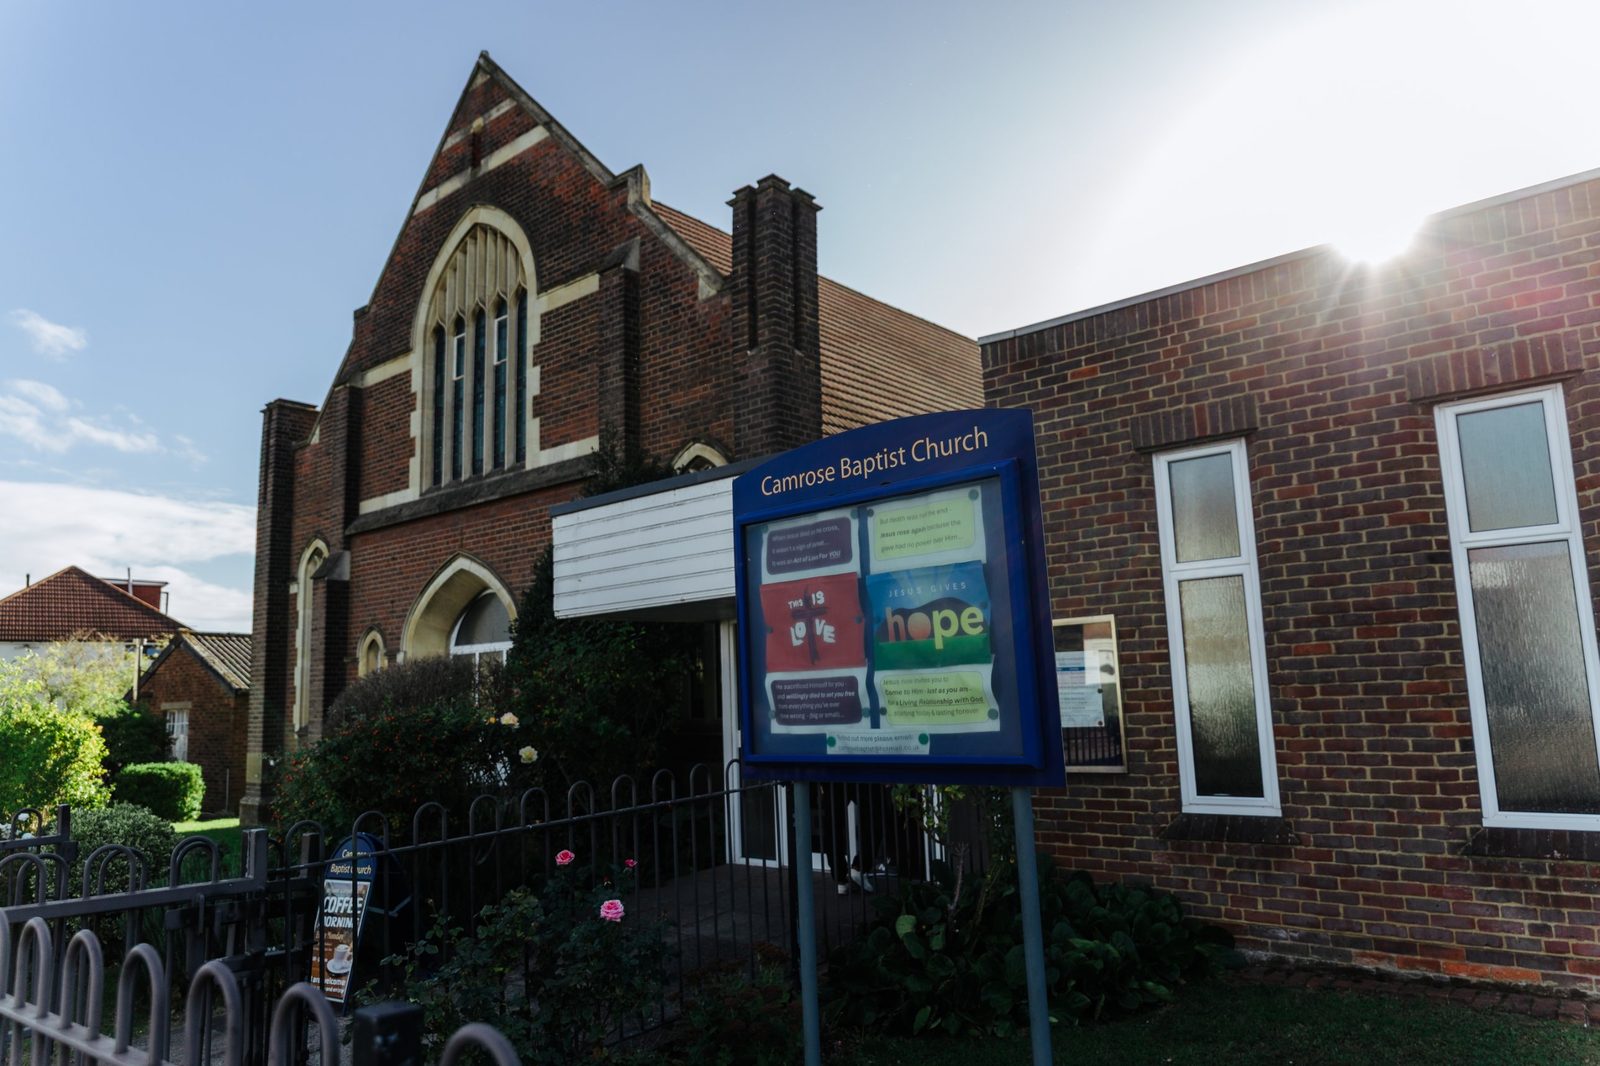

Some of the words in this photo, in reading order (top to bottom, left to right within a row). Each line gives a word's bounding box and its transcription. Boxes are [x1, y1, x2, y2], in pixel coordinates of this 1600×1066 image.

[760, 464, 835, 496] Camrose
[840, 446, 906, 480] Baptist
[911, 426, 988, 462] Church
[888, 586, 922, 598] JESUS
[930, 581, 967, 592] GIVES
[788, 598, 804, 609] THIS
[811, 591, 825, 605] IS
[790, 618, 836, 646] LOVE
[885, 606, 984, 650] hope
[330, 864, 350, 874] Baptist
[350, 864, 372, 875] urch
[324, 916, 360, 928] ORNIN
